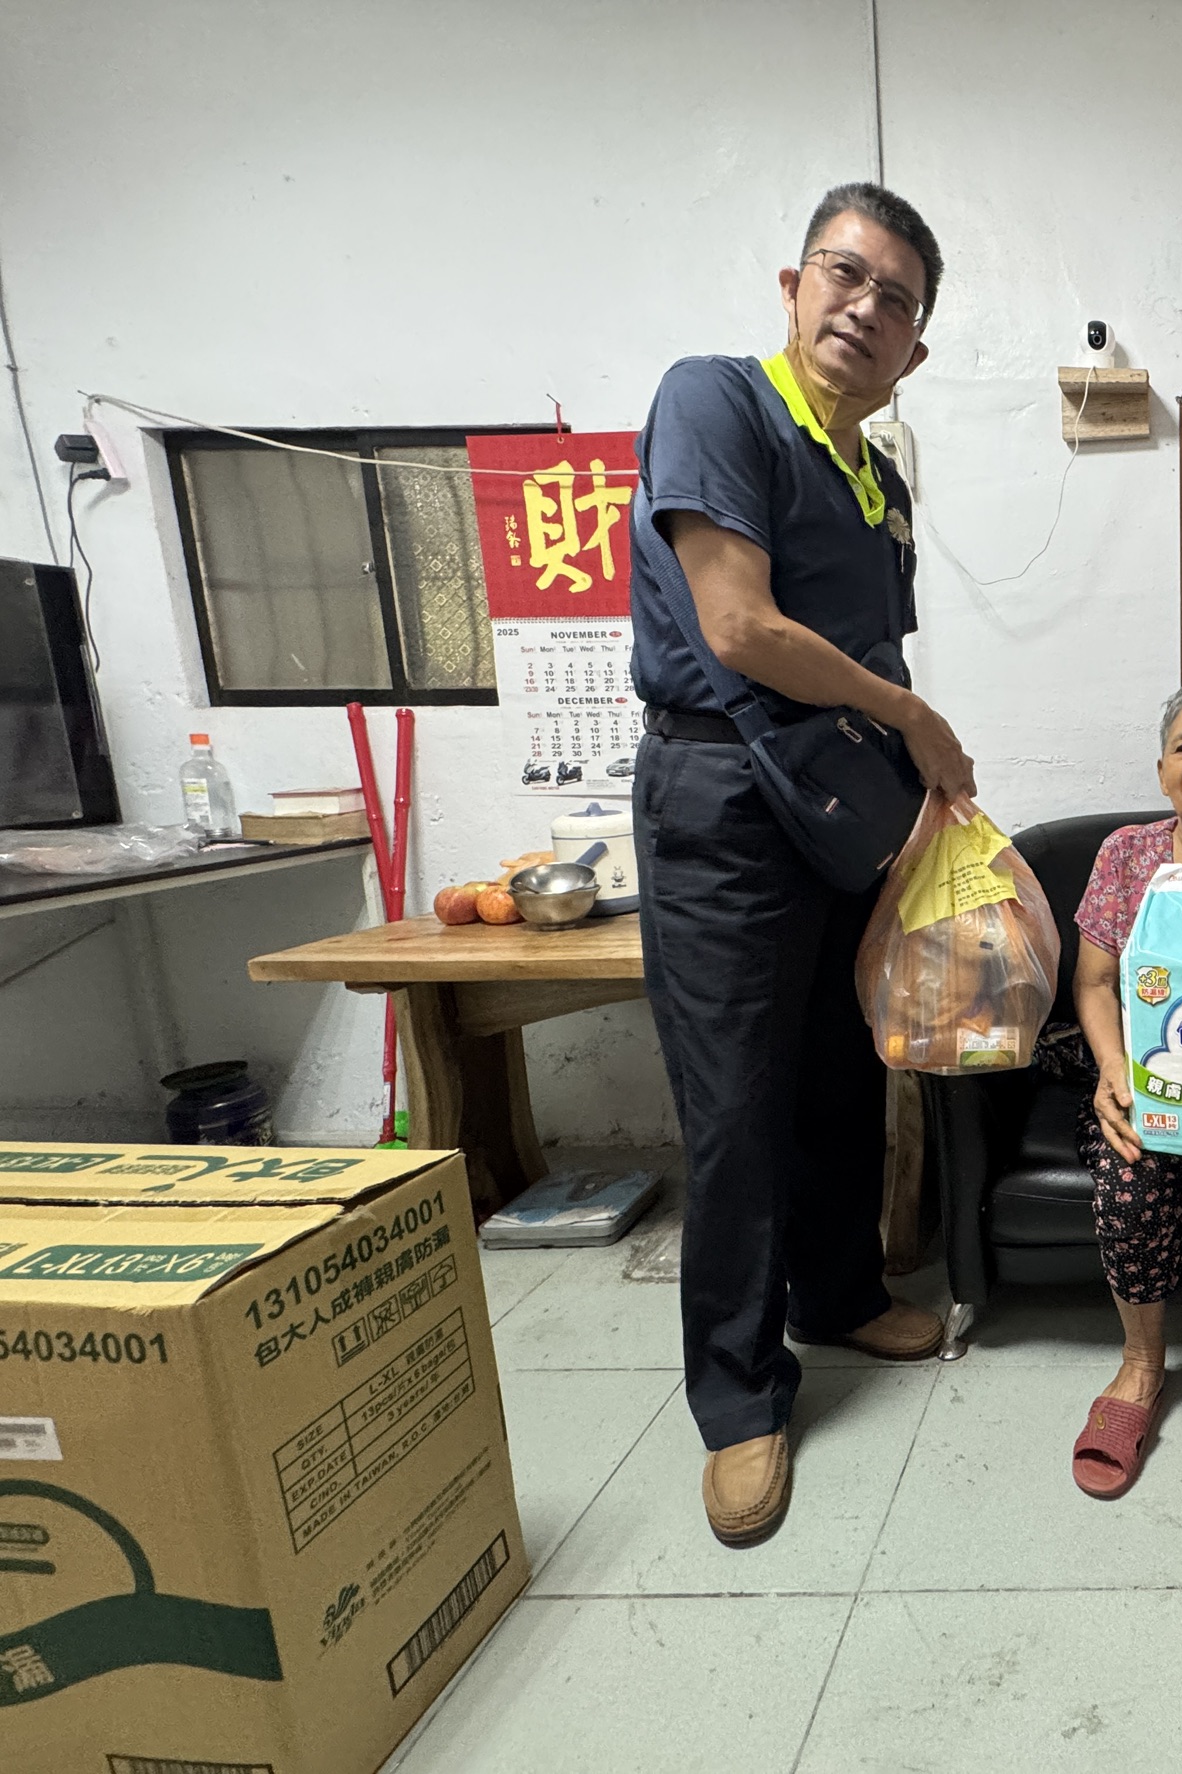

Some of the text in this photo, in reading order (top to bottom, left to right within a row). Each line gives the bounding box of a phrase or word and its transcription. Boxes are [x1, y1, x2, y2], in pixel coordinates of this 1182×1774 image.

[522, 458, 633, 593] 財
[496, 628, 519, 637] 2025
[551, 631, 608, 640] NOVEMBER
[558, 697, 614, 705] DECEMBER
[244, 1190, 445, 1330] 131054034001
[368, 1367, 399, 1395] L-XL
[296, 1425, 324, 1450] SIZE
[301, 1446, 328, 1471] QTY.
[302, 1504, 336, 1538] MADE
[340, 1491, 351, 1506] IN
